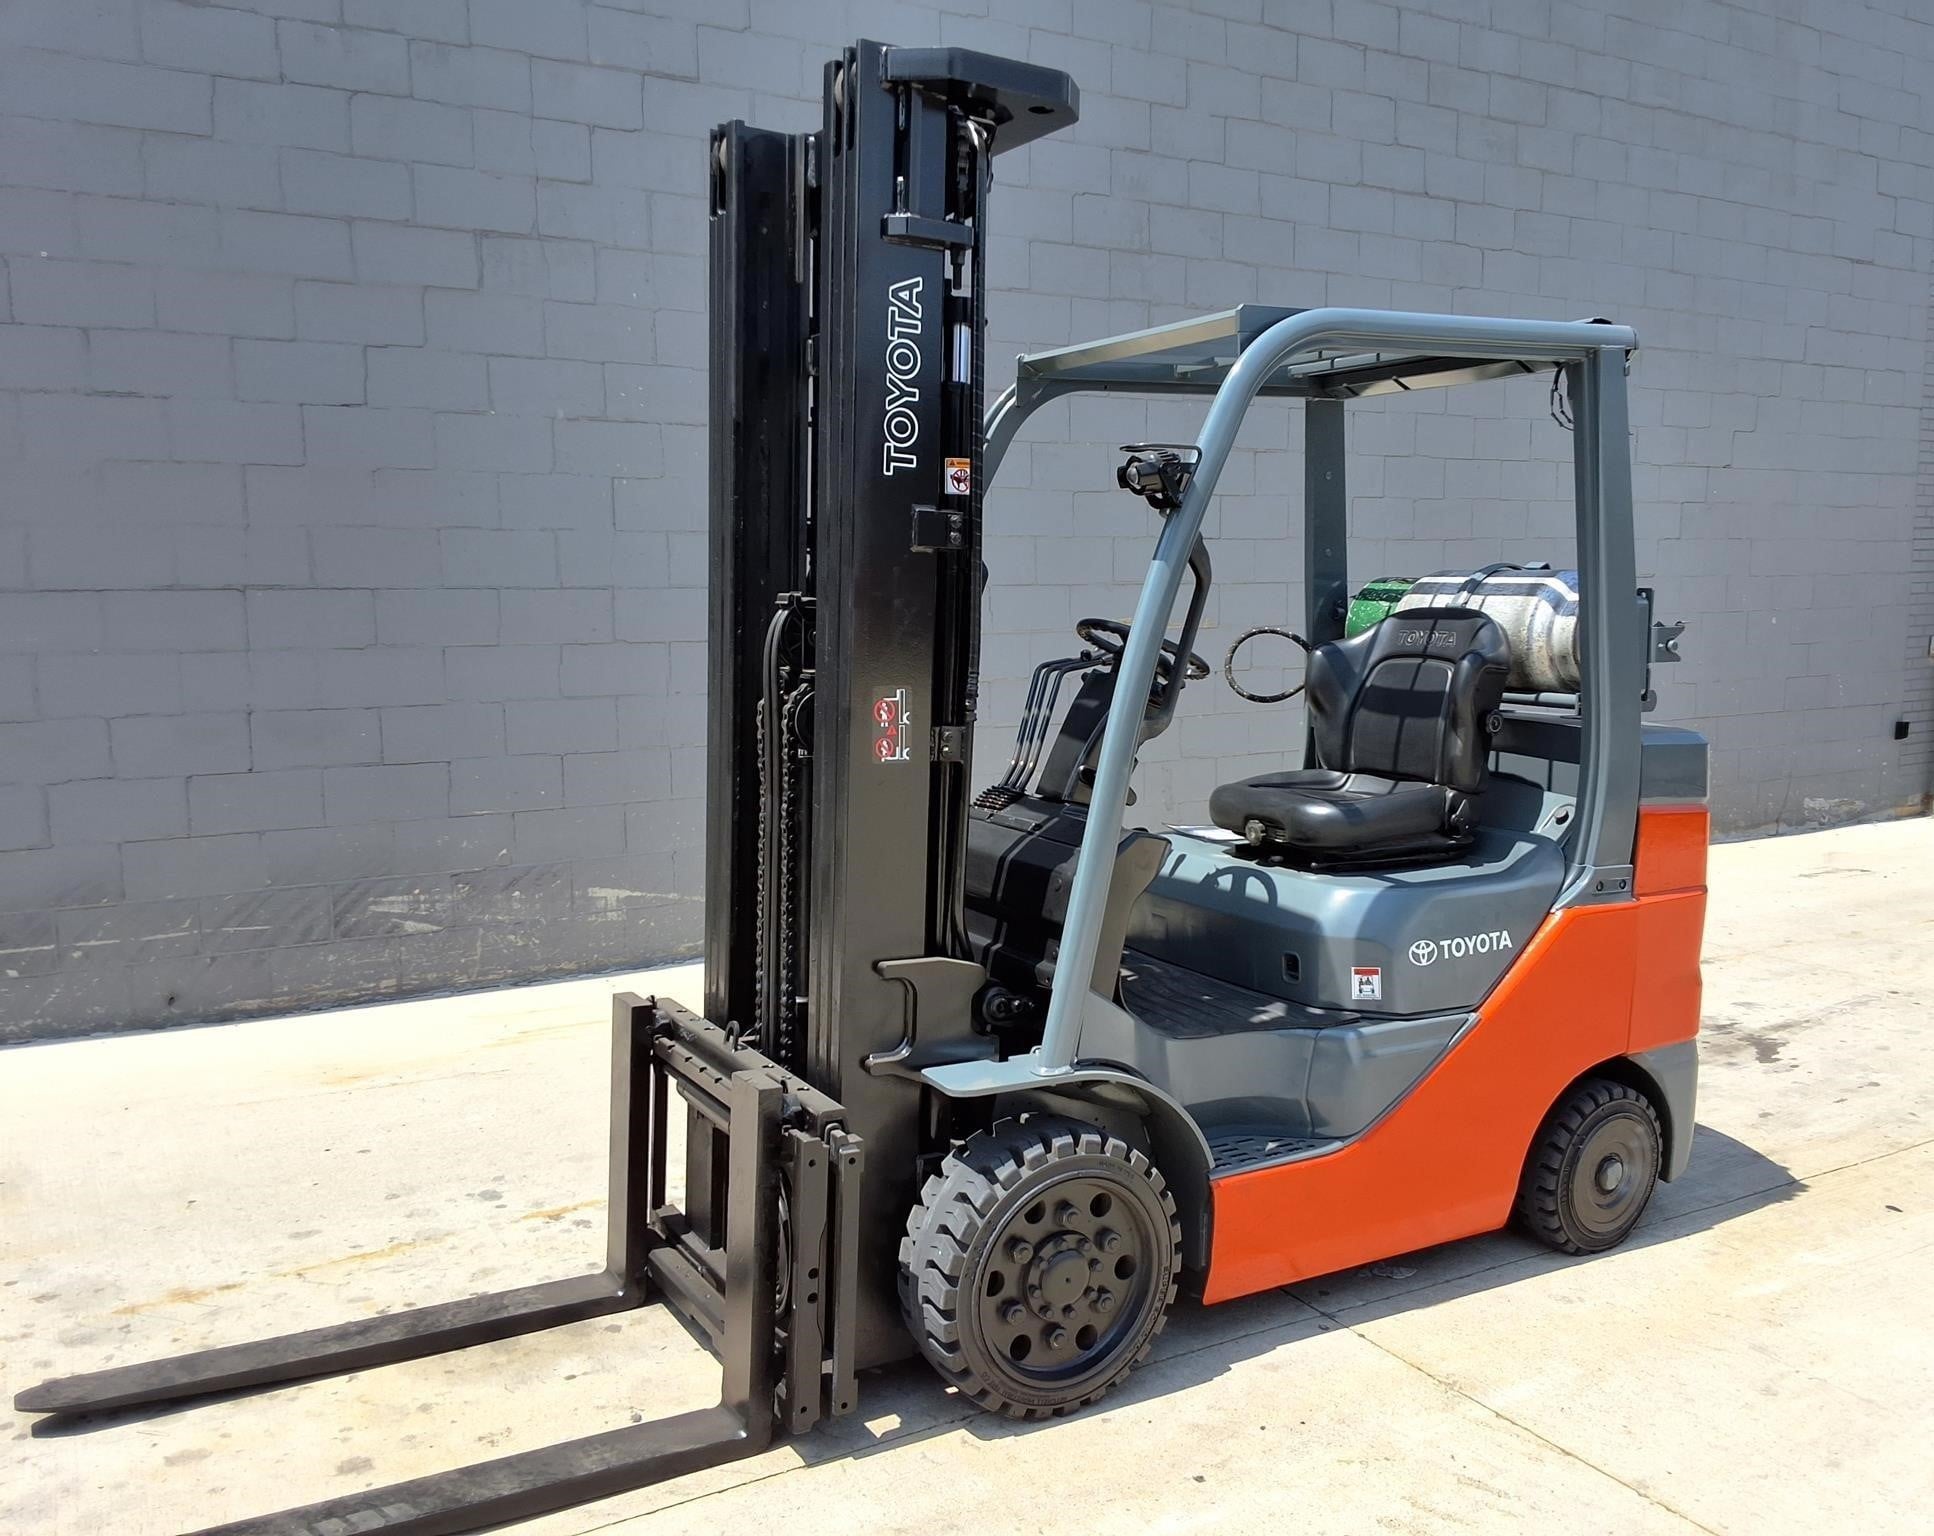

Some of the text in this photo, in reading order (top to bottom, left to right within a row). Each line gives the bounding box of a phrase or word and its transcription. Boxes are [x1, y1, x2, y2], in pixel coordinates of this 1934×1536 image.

[883, 277, 923, 475] TOYOTA
[1399, 629, 1457, 647] TOYOTA
[1439, 930, 1513, 959] TOYOTA
